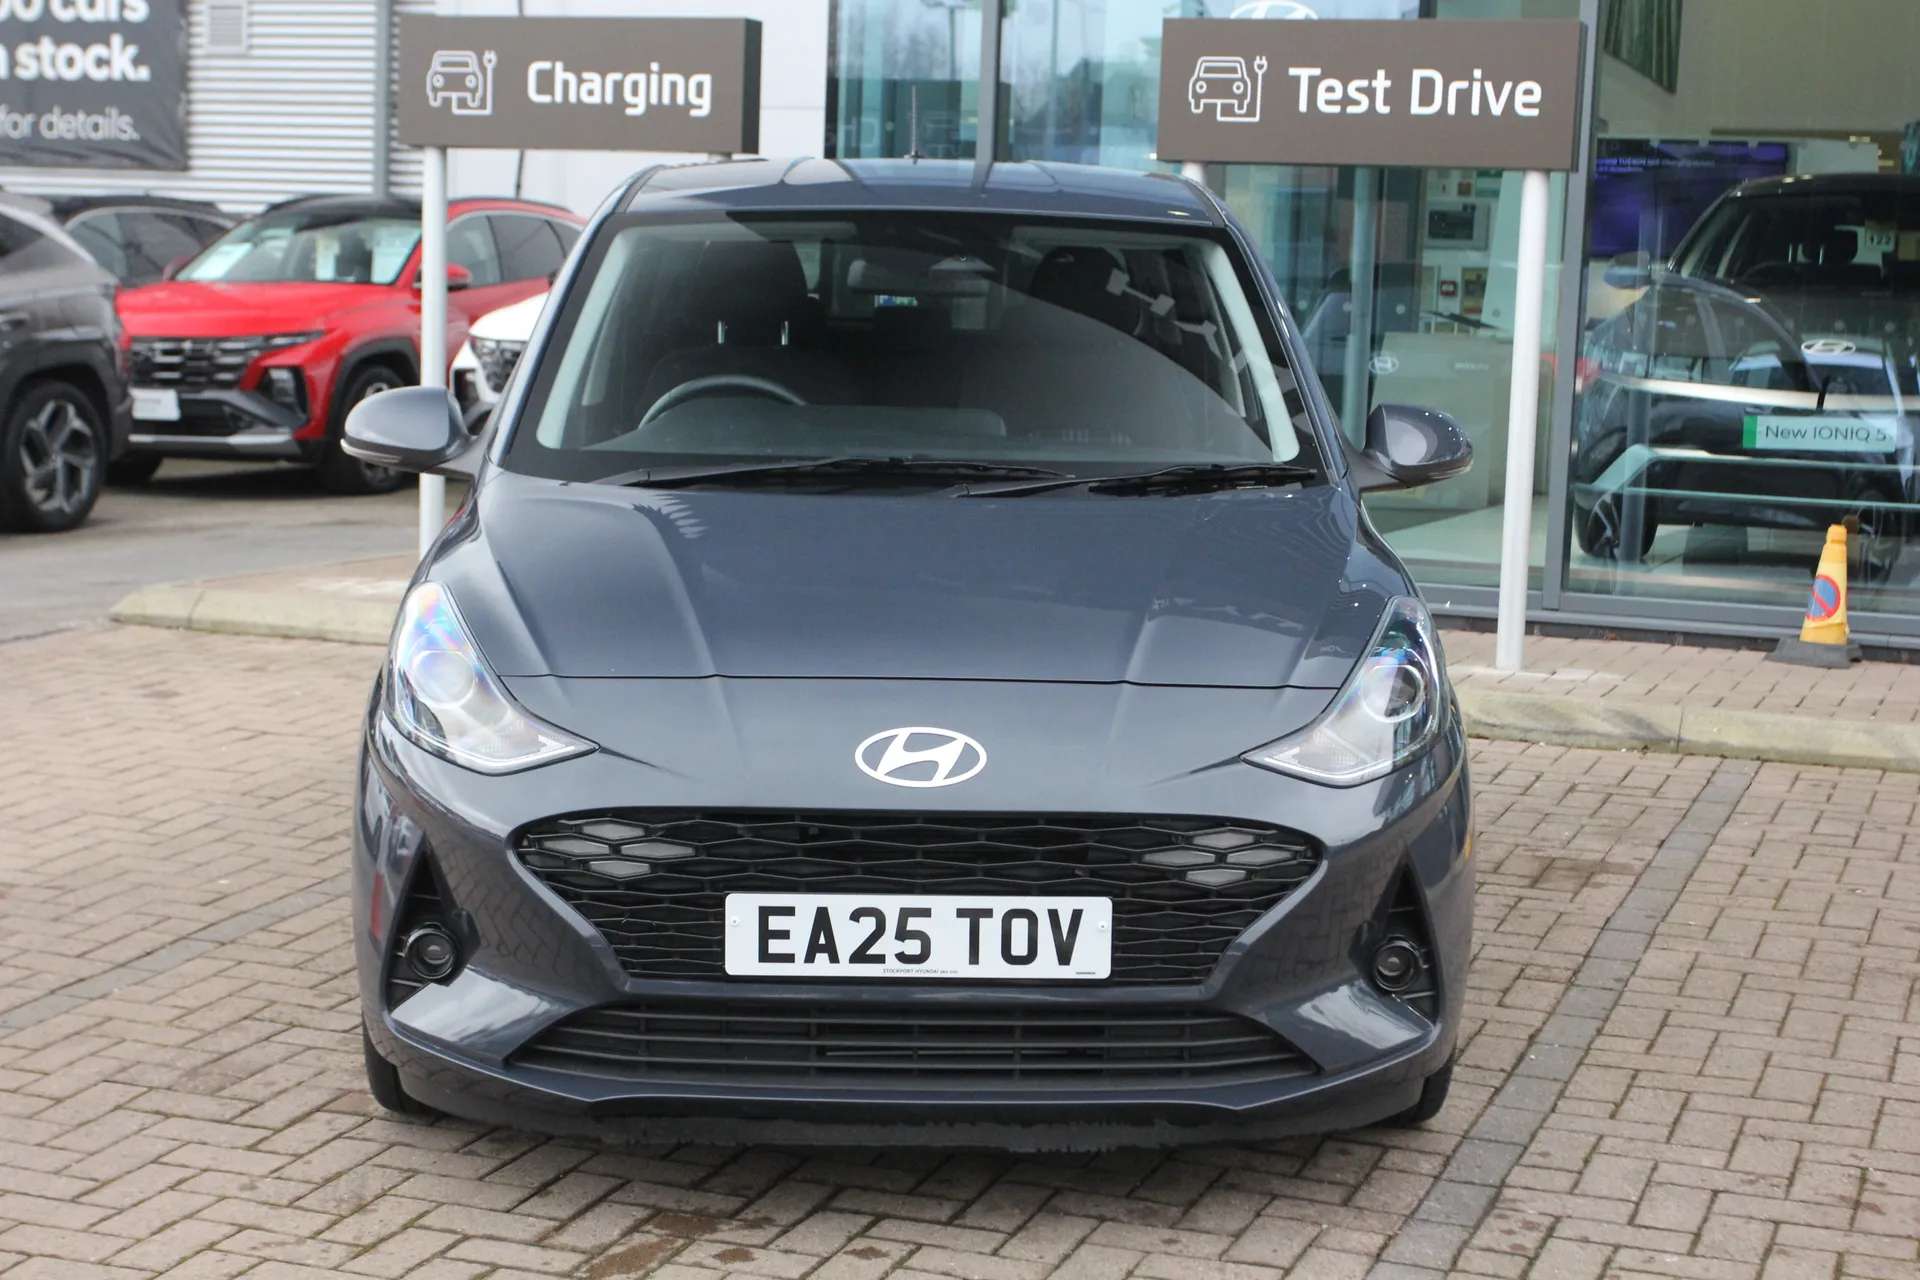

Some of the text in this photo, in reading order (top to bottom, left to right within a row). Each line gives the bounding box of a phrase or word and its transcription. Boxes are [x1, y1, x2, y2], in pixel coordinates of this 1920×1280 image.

[14, 32, 152, 81] stock.
[527, 60, 713, 118] Charging
[1288, 67, 1543, 118] Test Drive
[39, 104, 141, 141] details.
[1765, 425, 1808, 440] New
[1813, 425, 1871, 443] IONIQ
[757, 904, 1084, 967] EA25 TOV
